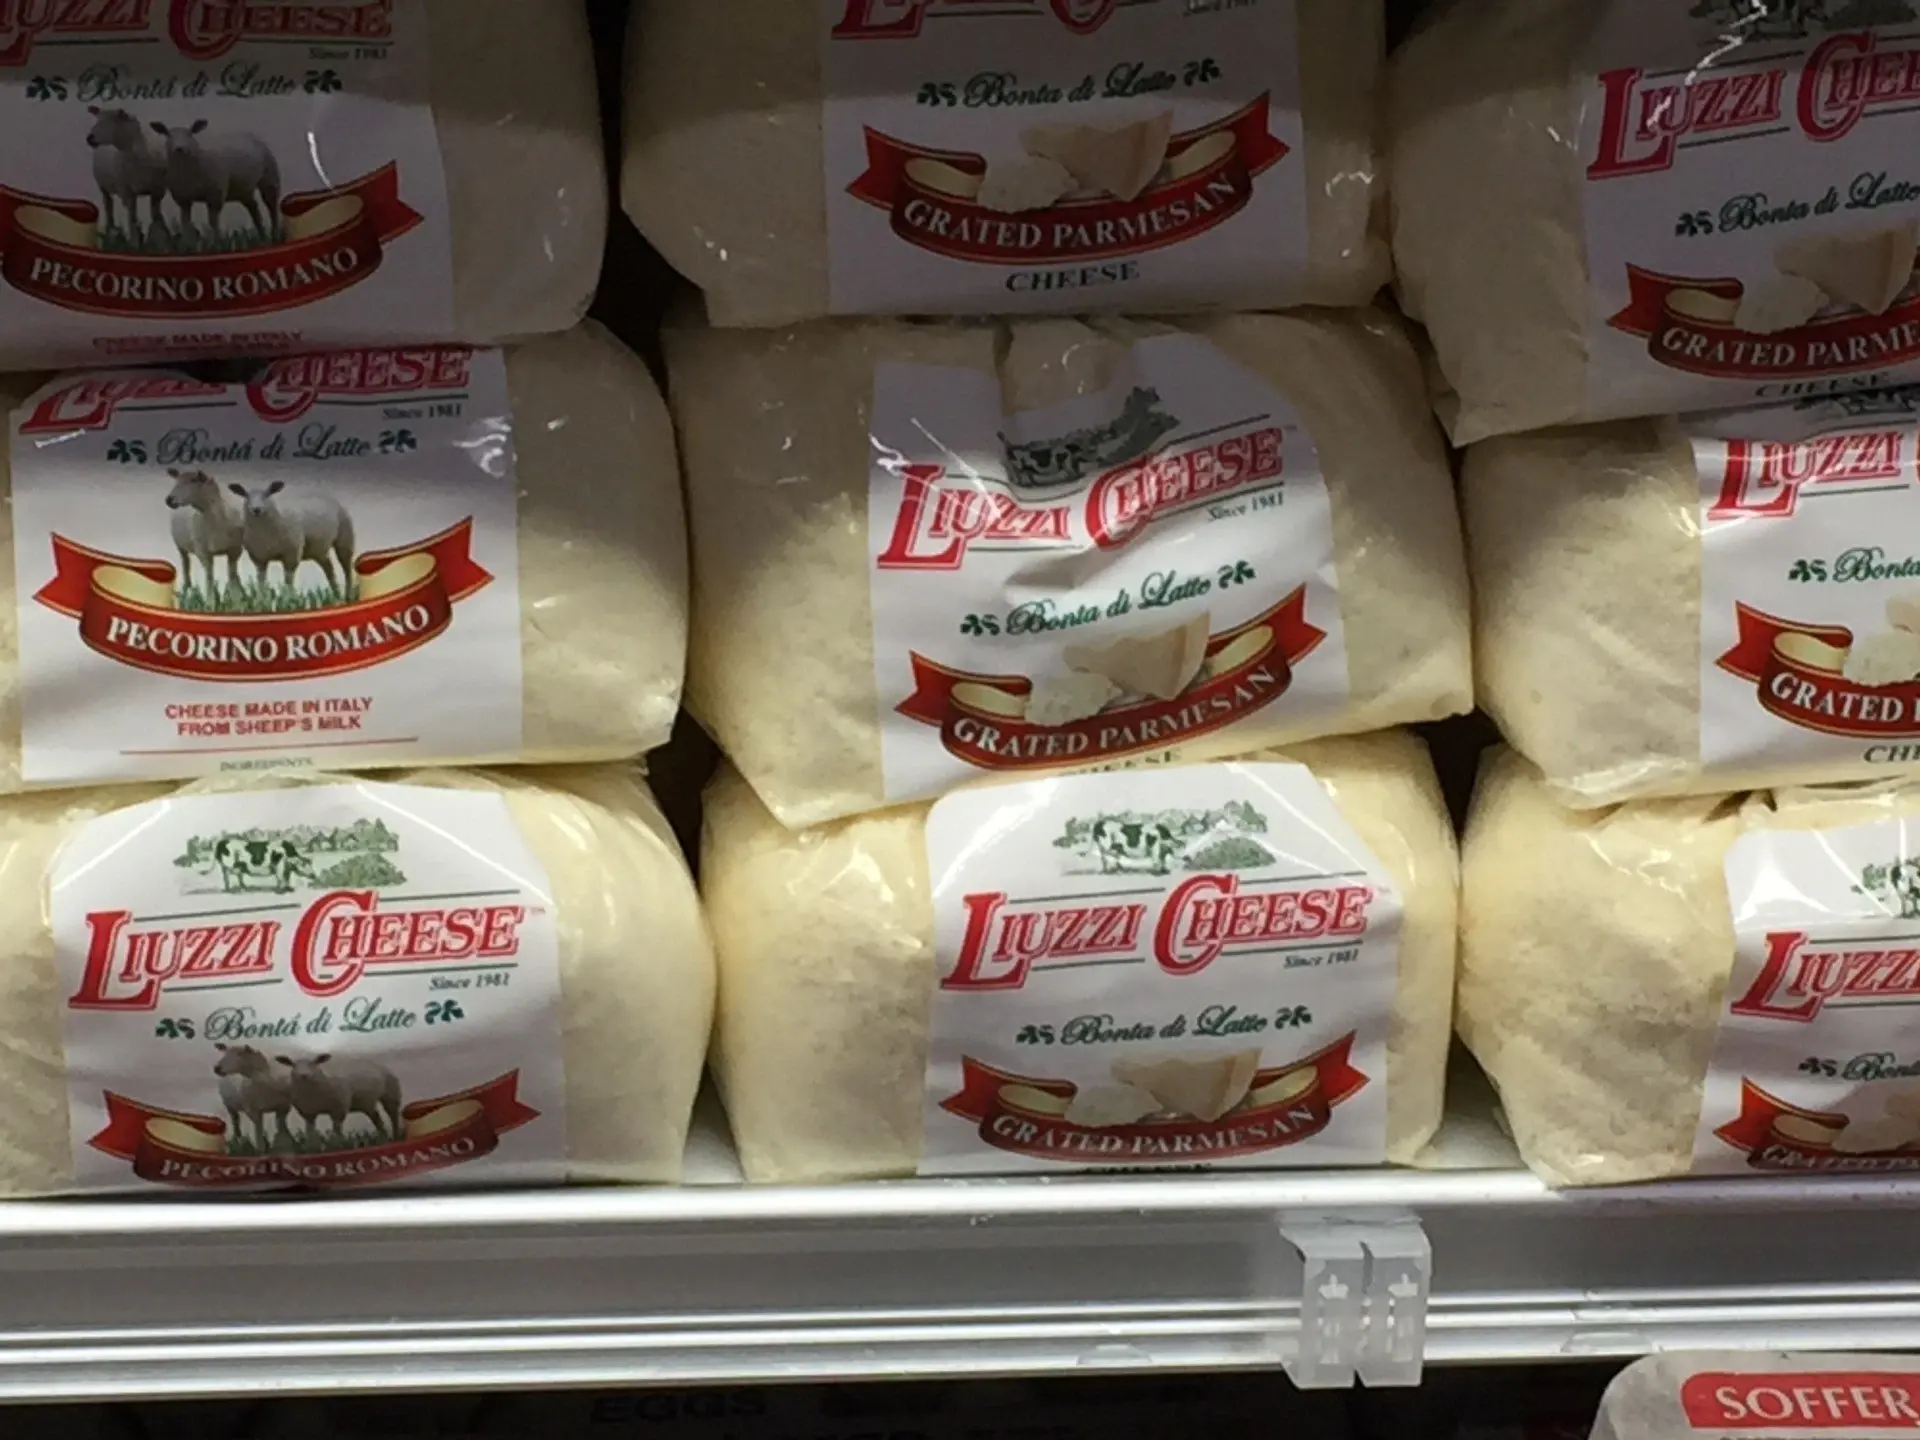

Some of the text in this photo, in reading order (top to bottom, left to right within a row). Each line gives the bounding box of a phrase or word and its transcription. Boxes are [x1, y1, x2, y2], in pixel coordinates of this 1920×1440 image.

[181, 71, 208, 98] di
[216, 62, 296, 98] Latte
[1068, 74, 1096, 101] di
[1102, 62, 1176, 99] Latte
[1587, 67, 1787, 180] LIUZZI
[904, 172, 1237, 249] GRATED PARMESAN
[1814, 186, 1840, 214] di
[30, 246, 359, 302] PECORINO ROMANO
[1006, 261, 1141, 292] CHEESE
[1662, 327, 1796, 367] GRATED
[260, 430, 286, 460] di
[293, 422, 371, 461] Latte
[877, 427, 1283, 569] LIUZZI CHEESE
[1708, 431, 1903, 521] LIUZZI
[1107, 593, 1132, 618] di
[1138, 571, 1212, 609] Latte
[107, 602, 430, 662] PECORINO ROMANO
[164, 697, 373, 720] CHEESE MADE IN ITALY
[954, 664, 1280, 759] GRATED PARMESAN
[1771, 670, 1905, 724] GRATED
[178, 721, 231, 737] FROM
[318, 715, 362, 731] MILK
[68, 890, 526, 1011] LIUZZI CHEESE
[941, 874, 1373, 990] LIUZZI CHEESE
[306, 1006, 332, 1034] di
[339, 997, 417, 1032] Latte
[1160, 1012, 1188, 1038] di
[1193, 1005, 1269, 1036] Latte
[993, 1103, 1316, 1156] GRATED PARMESAN
[160, 1136, 476, 1180] PECORINO ROMANO
